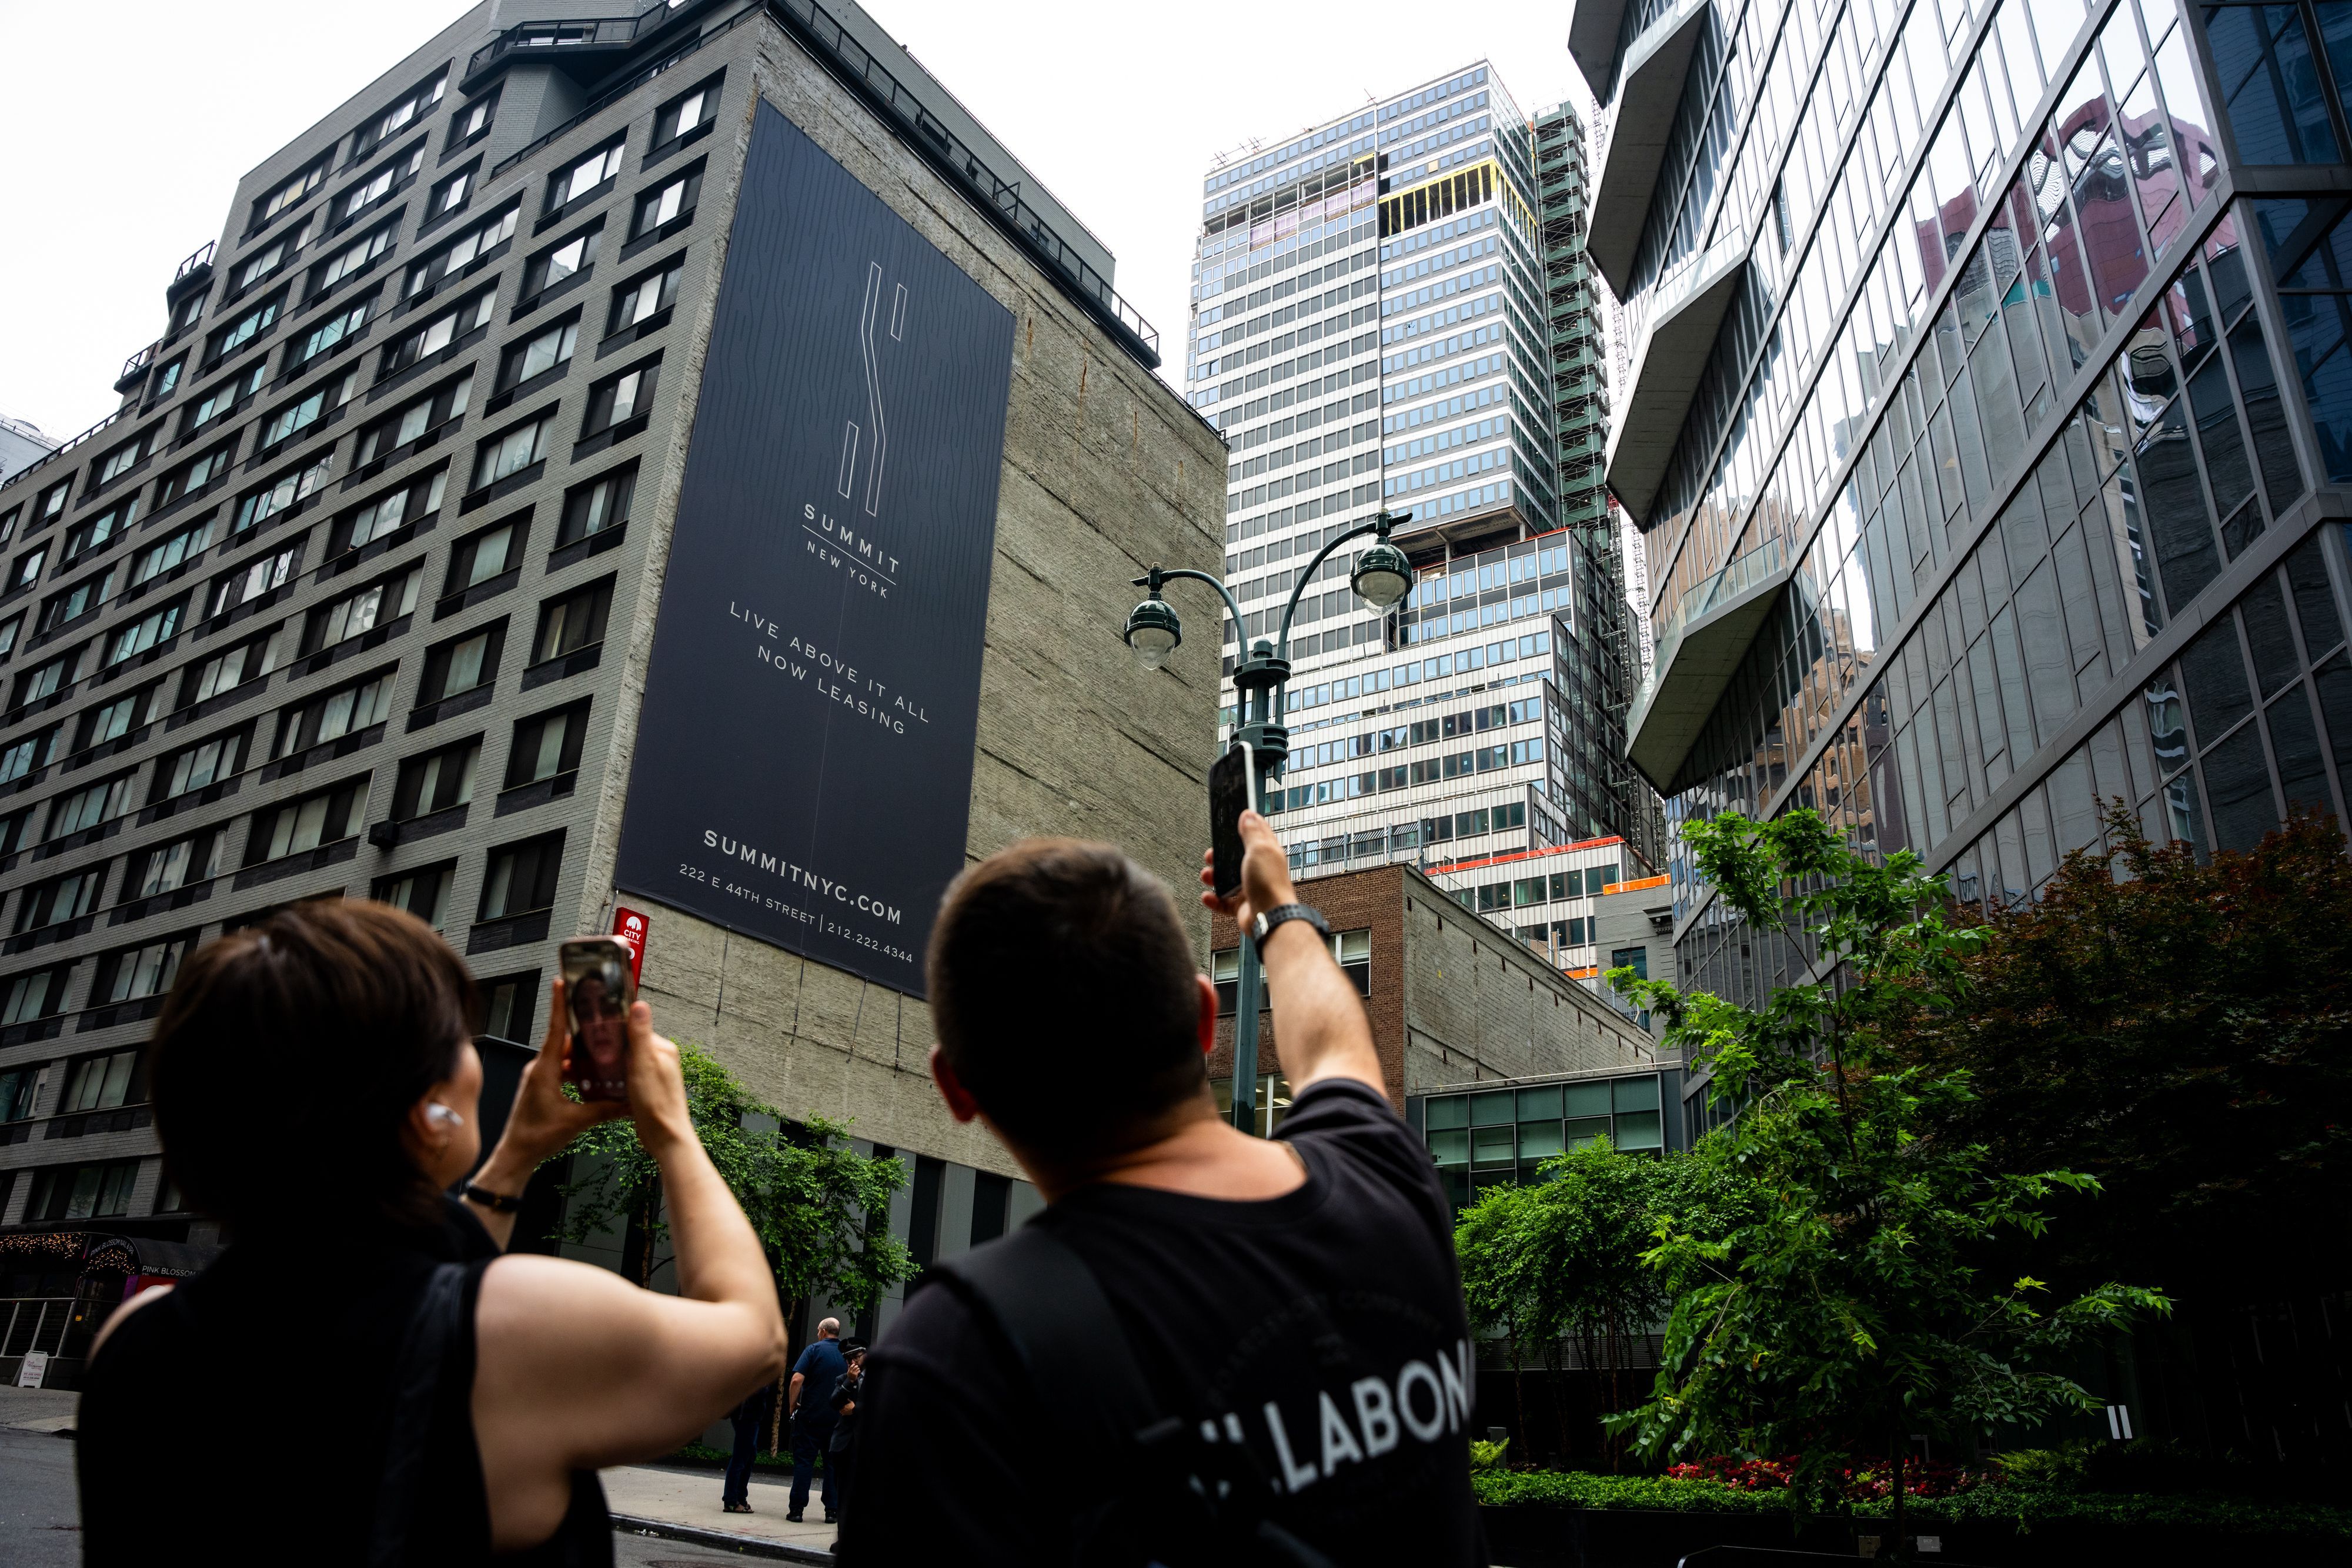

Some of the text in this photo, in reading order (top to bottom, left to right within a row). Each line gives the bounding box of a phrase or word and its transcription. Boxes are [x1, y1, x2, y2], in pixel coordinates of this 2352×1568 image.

[804, 503, 900, 574] SUMMIT
[807, 540, 887, 599] NEW YORK
[730, 601, 928, 723] LIVE ABOVE IT ALL
[757, 645, 904, 734] NOW LEASING
[679, 864, 913, 963] 222 E 44TH STREET 212.222.4344
[703, 830, 901, 925] SUMMITNYC.COM
[624, 930, 641, 940] CITY
[142, 1265, 160, 1273] PINK
